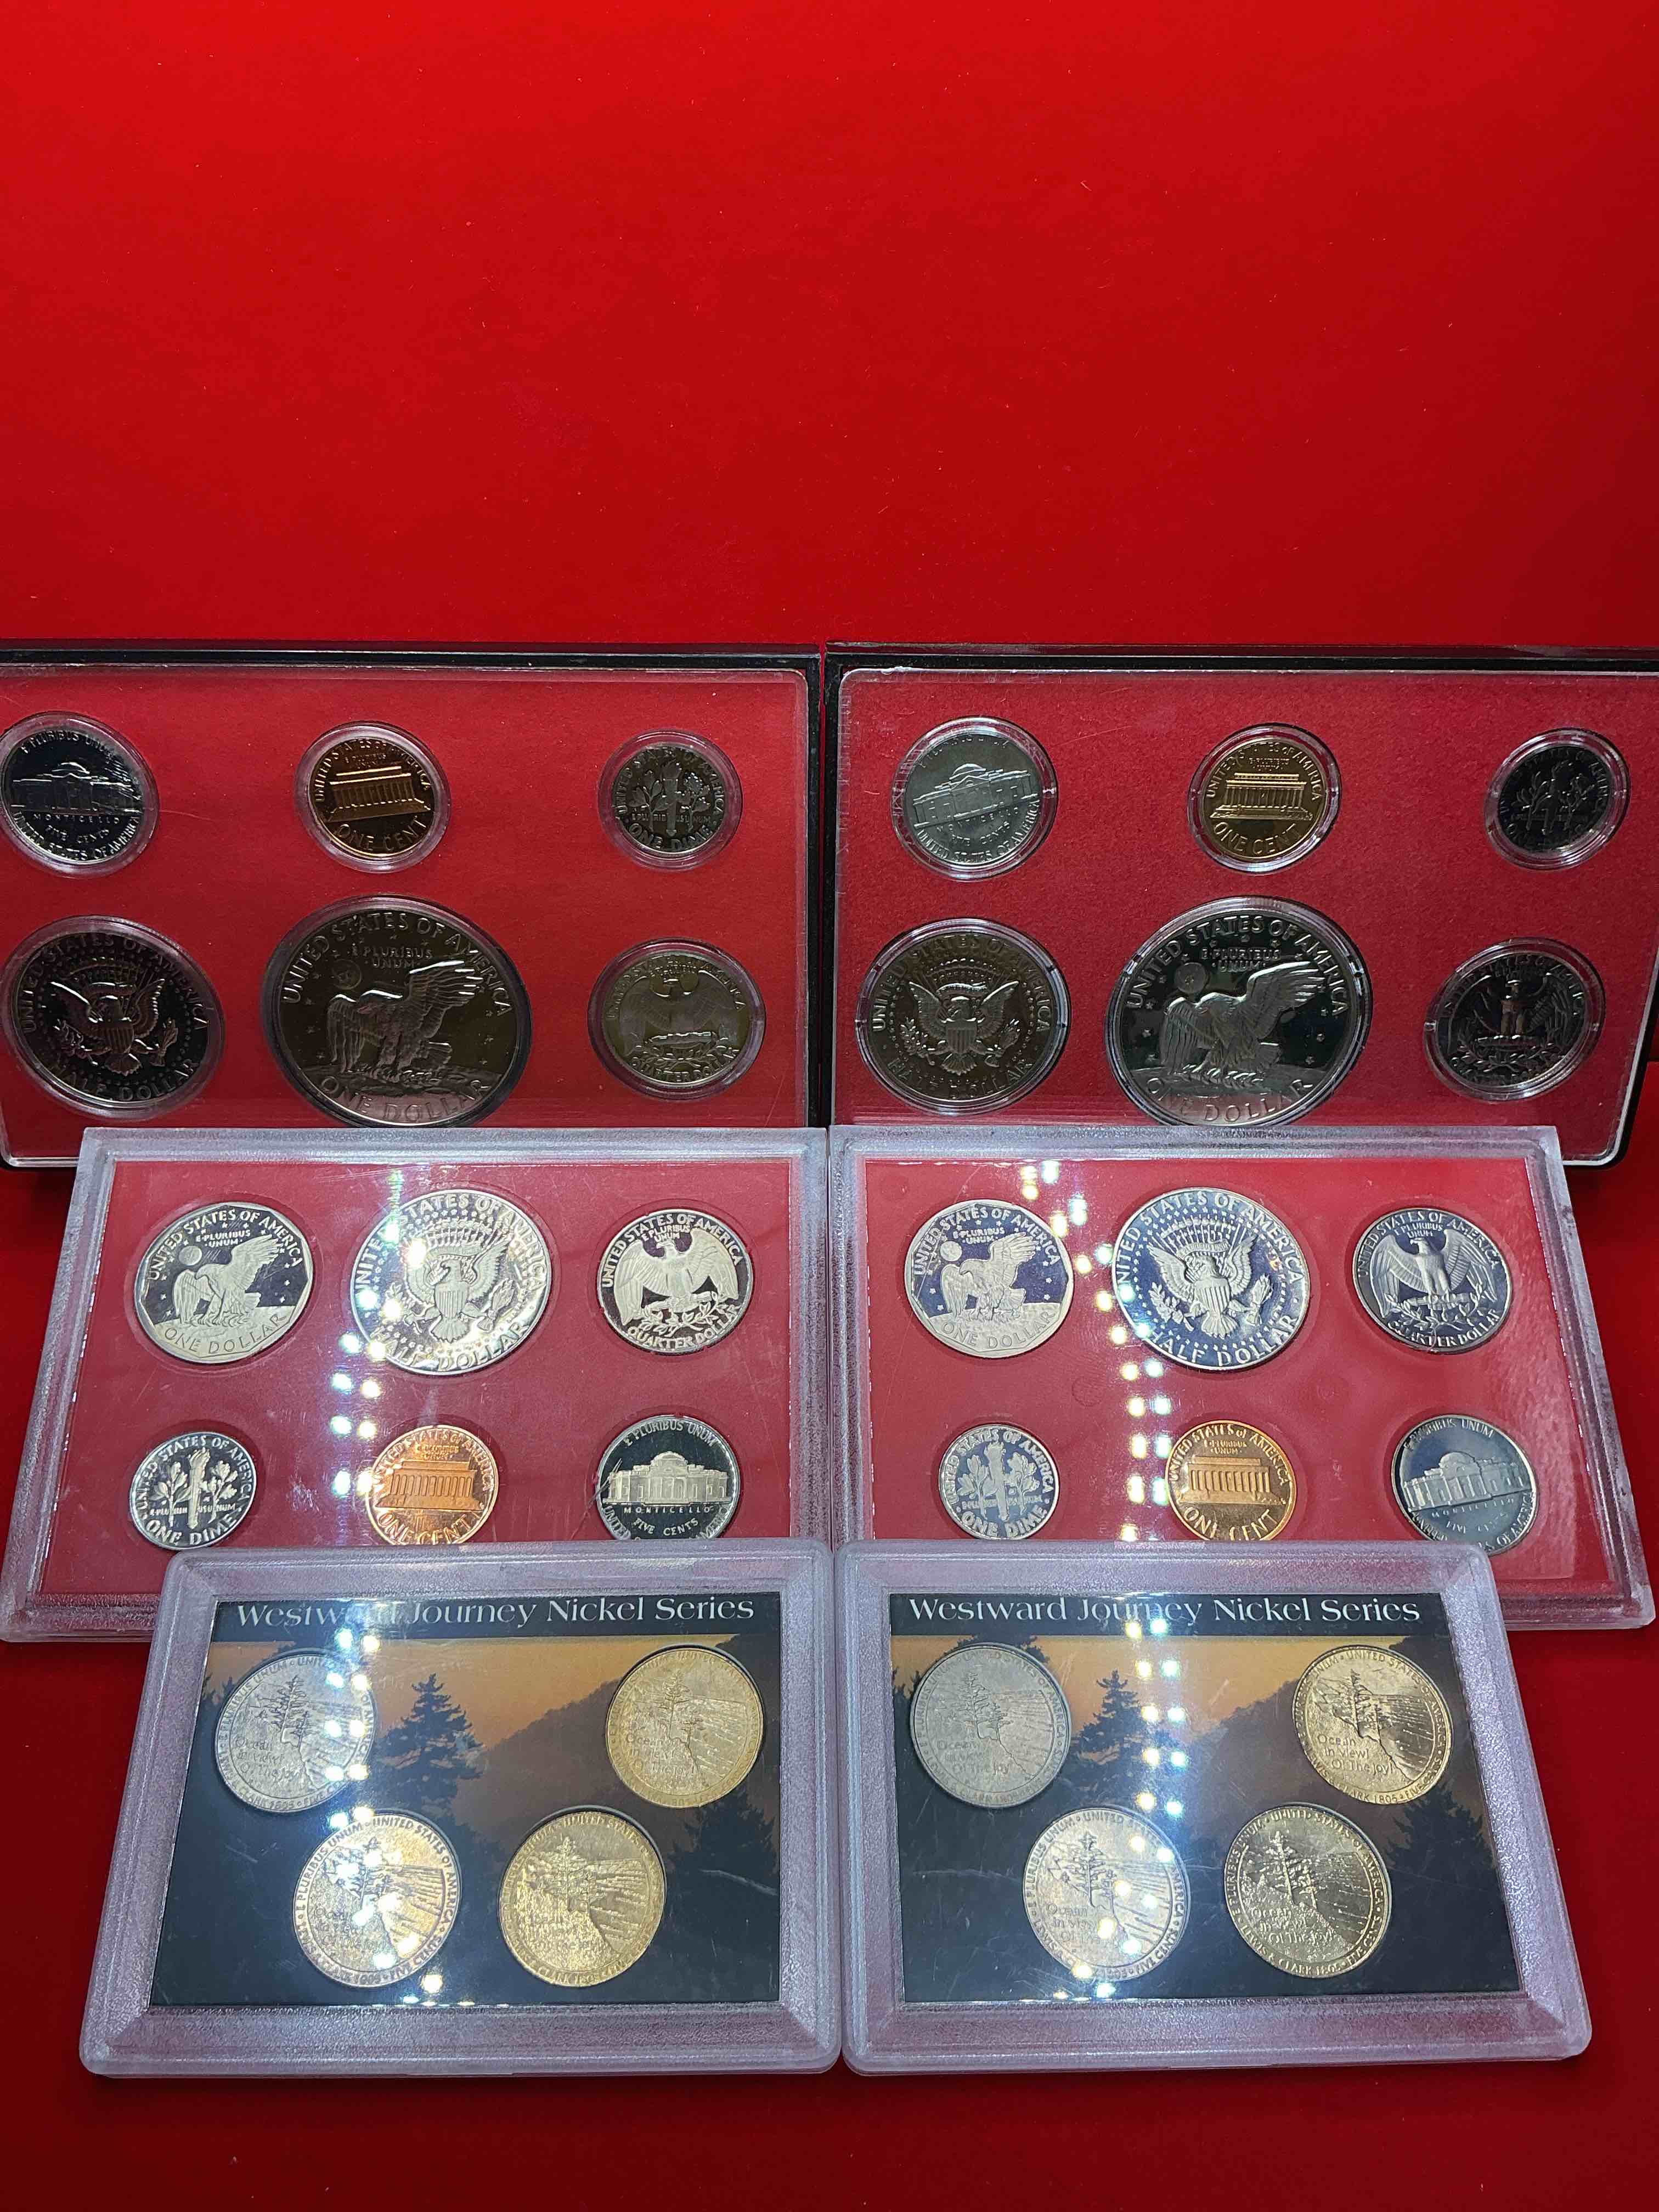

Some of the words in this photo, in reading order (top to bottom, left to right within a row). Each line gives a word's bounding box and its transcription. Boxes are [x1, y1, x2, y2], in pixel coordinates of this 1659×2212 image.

[1207, 756, 1236, 798] UNITED
[1292, 751, 1322, 800] AMERICA
[33, 813, 120, 824] MONTICELLO
[337, 824, 374, 850] ONE
[385, 815, 426, 850] CENT
[1214, 822, 1248, 851] ONE
[1253, 823, 1299, 854] CENT
[283, 935, 330, 1004] UNITED
[331, 912, 409, 941] STATES
[416, 918, 445, 938] OF
[445, 933, 514, 1017] AMERICA
[1126, 940, 1182, 1008] UNITED
[1185, 916, 1263, 944] STATES
[1268, 920, 1299, 940] OF
[1295, 934, 1348, 1015] AMERICA
[385, 1080, 491, 1121] DOLLAR
[1205, 1079, 1313, 1122] DOLLAR
[475, 1198, 500, 1212] OF
[148, 1232, 183, 1280] UNITED
[183, 1209, 236, 1234] STATES
[240, 1211, 260, 1222] OF
[258, 1216, 303, 1267] AMERICA
[204, 1230, 250, 1240] PLURIBUS
[648, 1224, 691, 1238] PLURIBUS
[654, 1232, 680, 1242] UNUM
[914, 1228, 943, 1276] UNITED
[940, 1207, 988, 1231] STATES
[991, 1208, 1011, 1221] OF
[1012, 1215, 1061, 1265] AMERICA
[1115, 1227, 1141, 1294] NITED
[1140, 1191, 1207, 1226] STATES
[1214, 1193, 1241, 1208] OF
[1244, 1206, 1304, 1284] AMERICA
[1358, 1233, 1379, 1278] UNITED
[1376, 1211, 1425, 1235] STATES
[1428, 1212, 1448, 1223] OF
[1447, 1218, 1502, 1269] AMERICA
[602, 1240, 627, 1288] UNITED
[624, 1214, 674, 1243] STATES
[677, 1214, 696, 1224] OF
[694, 1218, 743, 1266] AMERICA
[164, 1328, 201, 1352] ONE
[208, 1314, 286, 1354] DOLLAR
[628, 1326, 695, 1348] QUARTER
[943, 1323, 978, 1346] ONE
[988, 1311, 1055, 1349] DOLLAR
[1152, 1331, 1206, 1364] HALF
[1217, 1314, 1296, 1367] DOLLAR
[633, 1420, 684, 1440] PLURIBUS
[687, 1421, 719, 1447] UNUM
[1461, 1419, 1493, 1438] UNUM
[158, 1435, 207, 1462] STATES
[211, 1438, 229, 1449] OF
[227, 1447, 251, 1501] AMERICA
[956, 1428, 999, 1457] STATES
[1019, 1440, 1054, 1493] AMERICA
[1169, 1439, 1193, 1483] UNITED
[1192, 1424, 1234, 1443] STATES
[1249, 1433, 1291, 1486] AMERICA
[146, 1520, 182, 1545] ONE
[189, 1514, 236, 1545] DIME
[633, 1517, 655, 1534] FIVE
[663, 1517, 698, 1536] CENTS
[961, 1511, 999, 1536] ONE
[1005, 1505, 1045, 1537] DIME
[1184, 1507, 1220, 1538] ONE
[1229, 1509, 1278, 1541] CENT
[238, 1602, 397, 1627] Westwd
[408, 1600, 537, 1628] Journey
[547, 1597, 644, 1622] Nickel
[654, 1596, 755, 1621] Series
[909, 1597, 1067, 1621] Westward
[1077, 1599, 1202, 1626] Journey
[1214, 1598, 1312, 1621] Nickel
[1321, 1598, 1421, 1622] Series
[1346, 1651, 1385, 1662] UNITED
[1318, 1733, 1356, 1746] Ocean
[1082, 1811, 1124, 1823] UNITED
[373, 1817, 413, 1830] UNITED
[415, 1825, 446, 1854] STATES
[1278, 1959, 1313, 1975] CLARK
